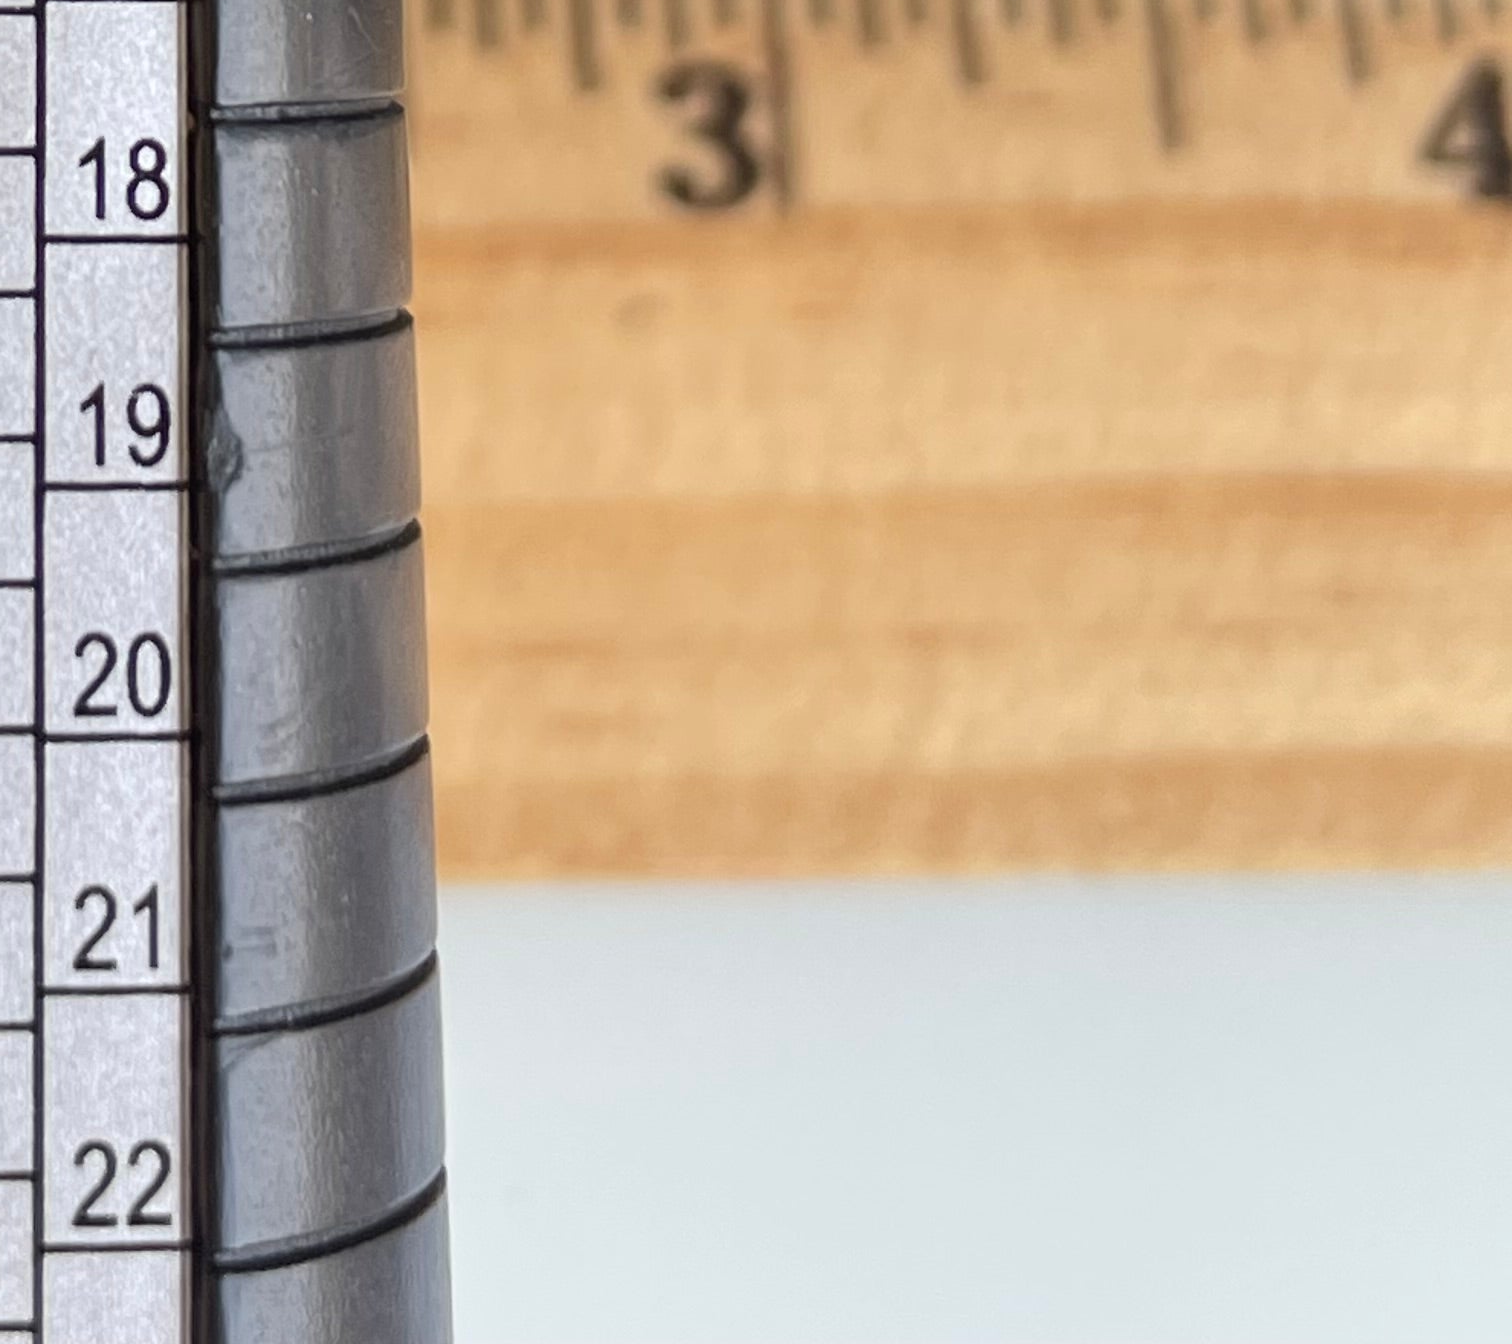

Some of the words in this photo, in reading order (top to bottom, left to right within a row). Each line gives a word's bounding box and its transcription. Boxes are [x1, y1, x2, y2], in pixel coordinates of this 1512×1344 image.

[656, 60, 758, 210] 3
[1417, 58, 1512, 200] 4
[79, 139, 169, 220] 18
[81, 384, 170, 467] 19
[74, 633, 170, 717] 20
[74, 886, 158, 970] 21
[73, 1142, 171, 1226] 22
